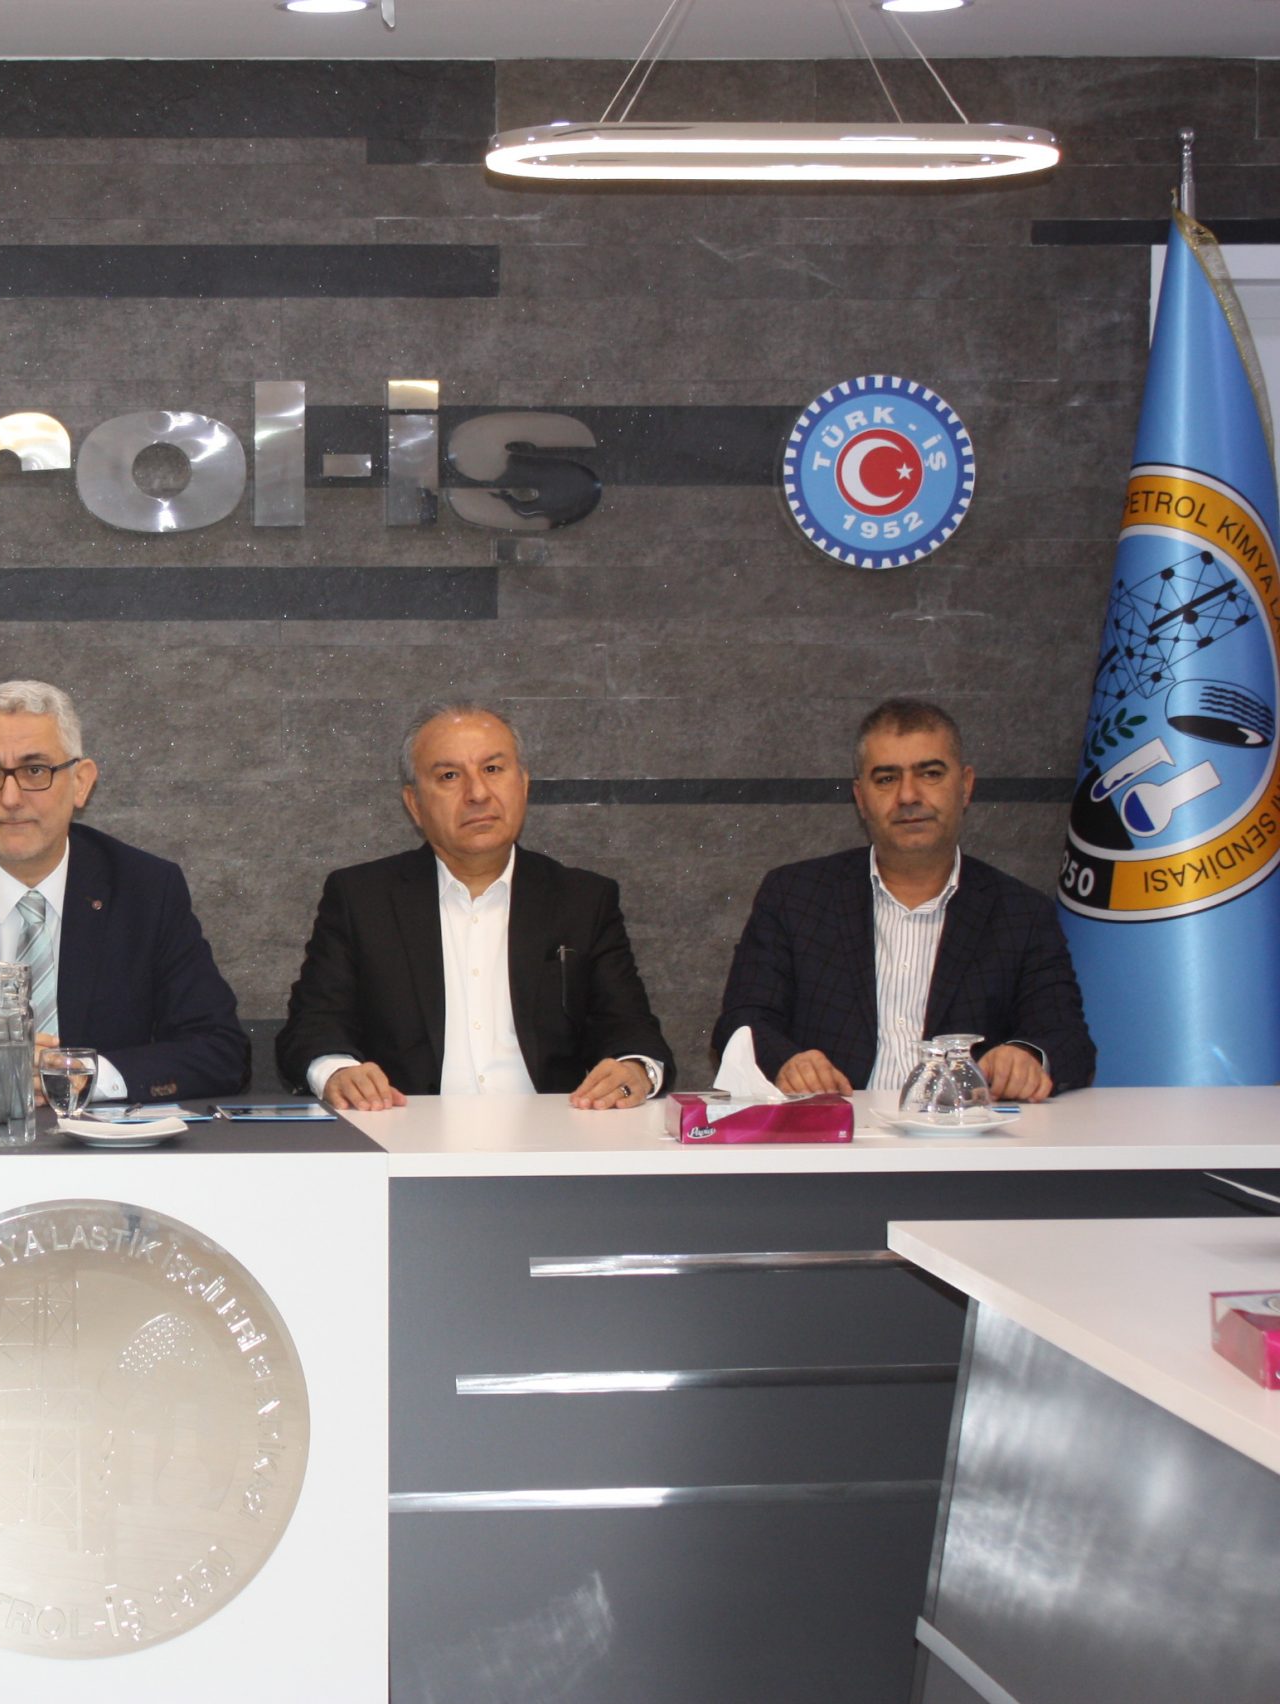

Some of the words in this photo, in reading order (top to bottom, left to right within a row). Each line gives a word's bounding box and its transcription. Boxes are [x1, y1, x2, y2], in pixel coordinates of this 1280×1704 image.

[843, 511, 924, 539] 1952
[1124, 490, 1208, 527] ETROL
[1217, 515, 1273, 594] KİMYA
[1144, 812, 1277, 894] SENDİKASI
